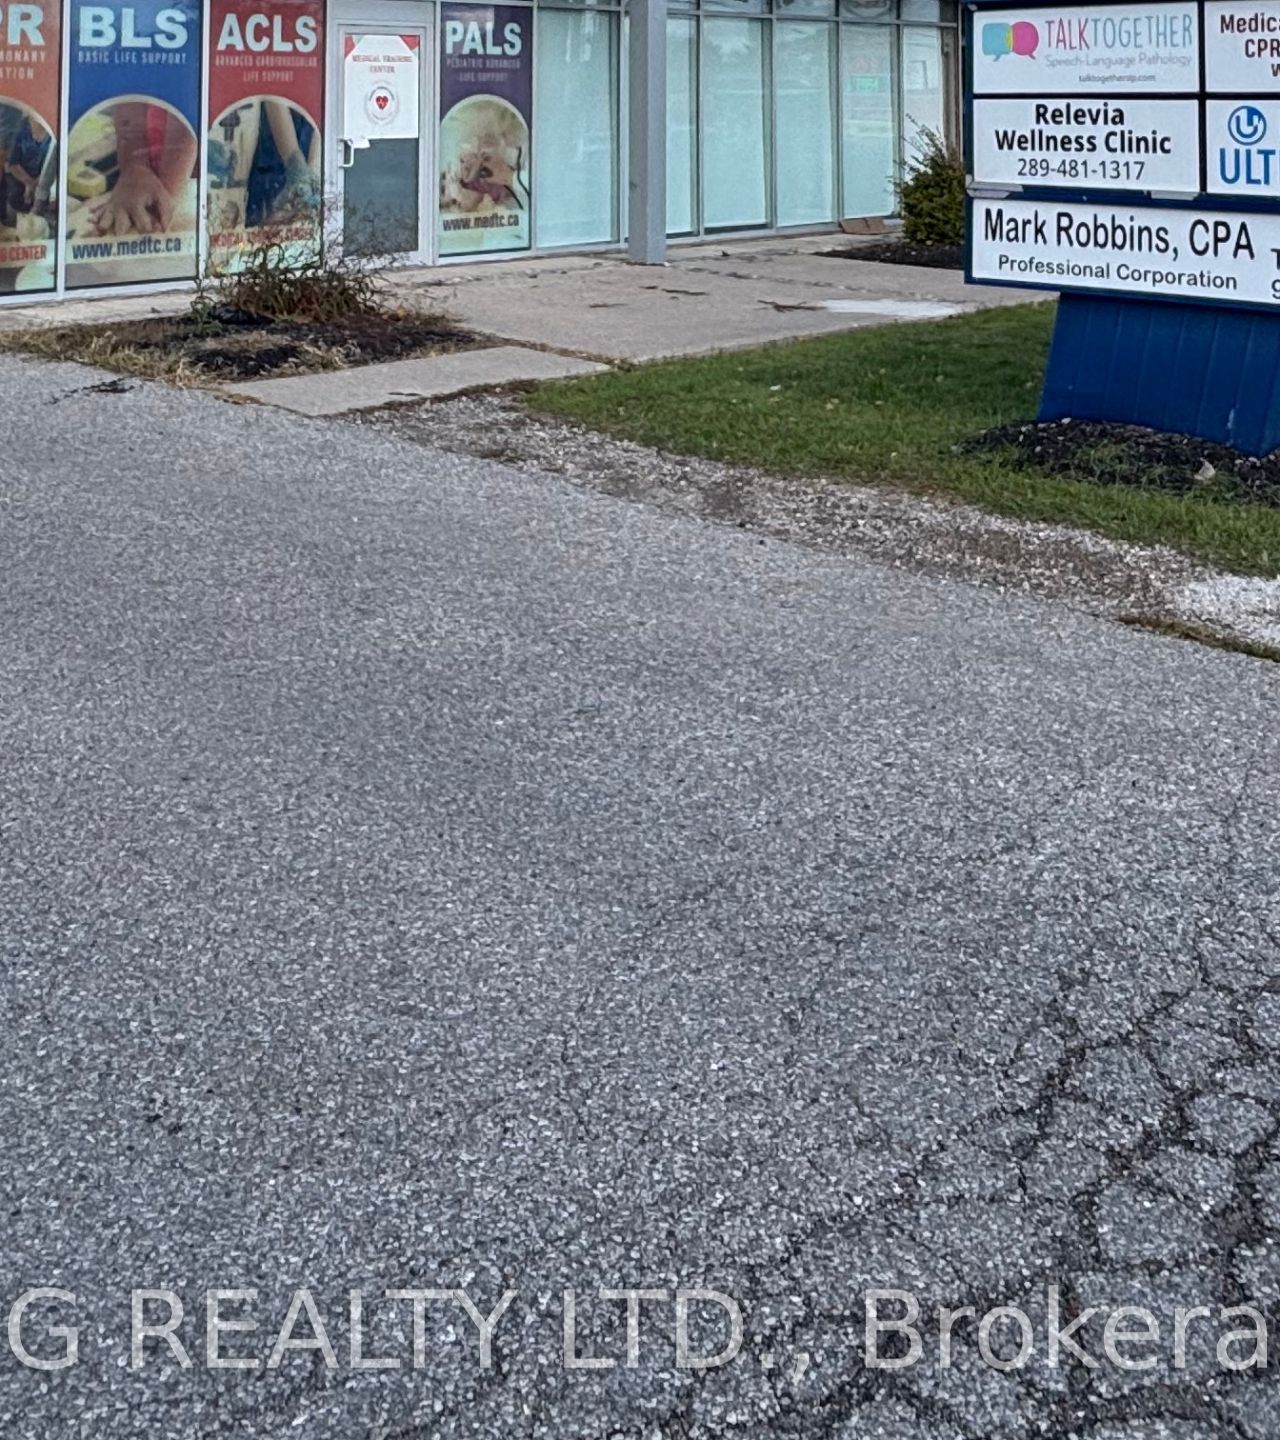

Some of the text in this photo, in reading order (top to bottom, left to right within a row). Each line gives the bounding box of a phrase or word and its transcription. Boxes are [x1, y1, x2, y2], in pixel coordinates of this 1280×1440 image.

[79, 6, 188, 49] BLS
[217, 13, 317, 53] ACLS
[445, 21, 521, 55] PALS
[1045, 13, 1194, 51] TALKTOGETHER
[78, 51, 187, 64] BASIC LIFE SUPPORT
[1035, 102, 1125, 125] Relevia
[995, 129, 1171, 154] Wellness Clinic
[1017, 158, 1145, 180] 289-481-1317
[443, 212, 519, 231] www.medtc.ca
[984, 207, 1255, 261] Mark Robbins, CPA
[8, 244, 47, 261] CENTER
[72, 236, 181, 260] www.medtc.ca
[998, 254, 1238, 290] Professional Corporation
